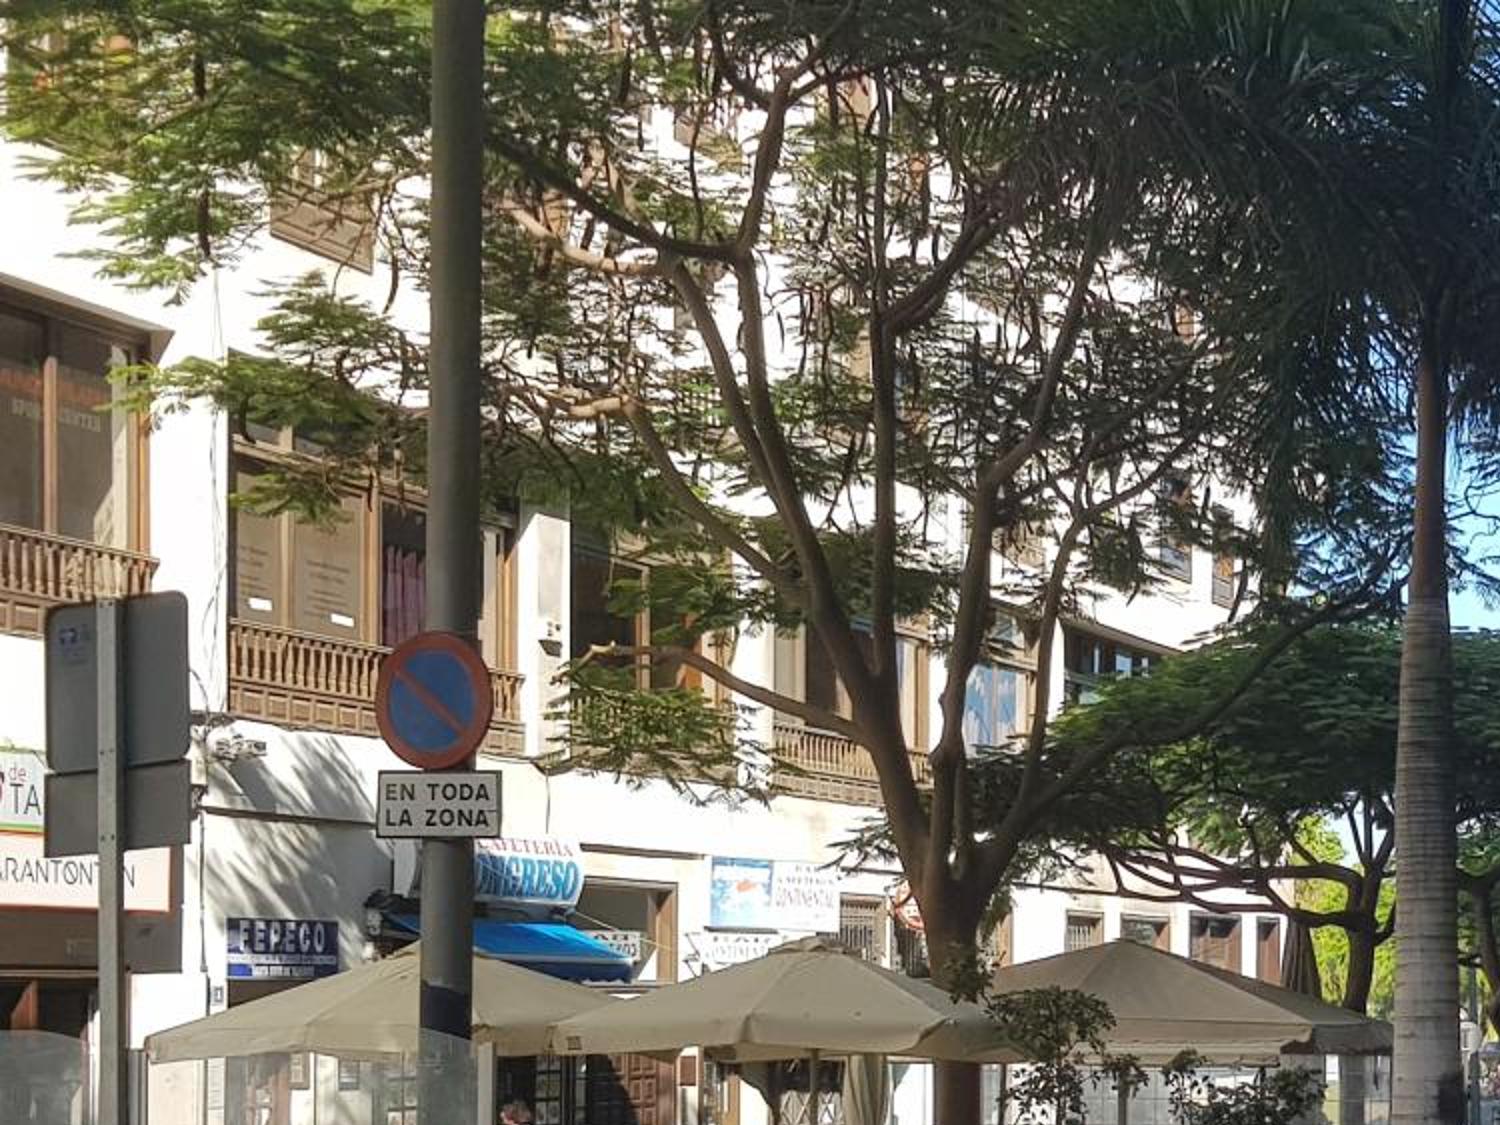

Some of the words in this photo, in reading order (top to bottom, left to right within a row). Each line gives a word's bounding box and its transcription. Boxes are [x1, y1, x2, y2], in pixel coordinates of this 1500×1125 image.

[385, 784, 415, 801] EN
[427, 784, 489, 801] TODA
[385, 809, 413, 827] LA
[425, 809, 489, 827] ZONA
